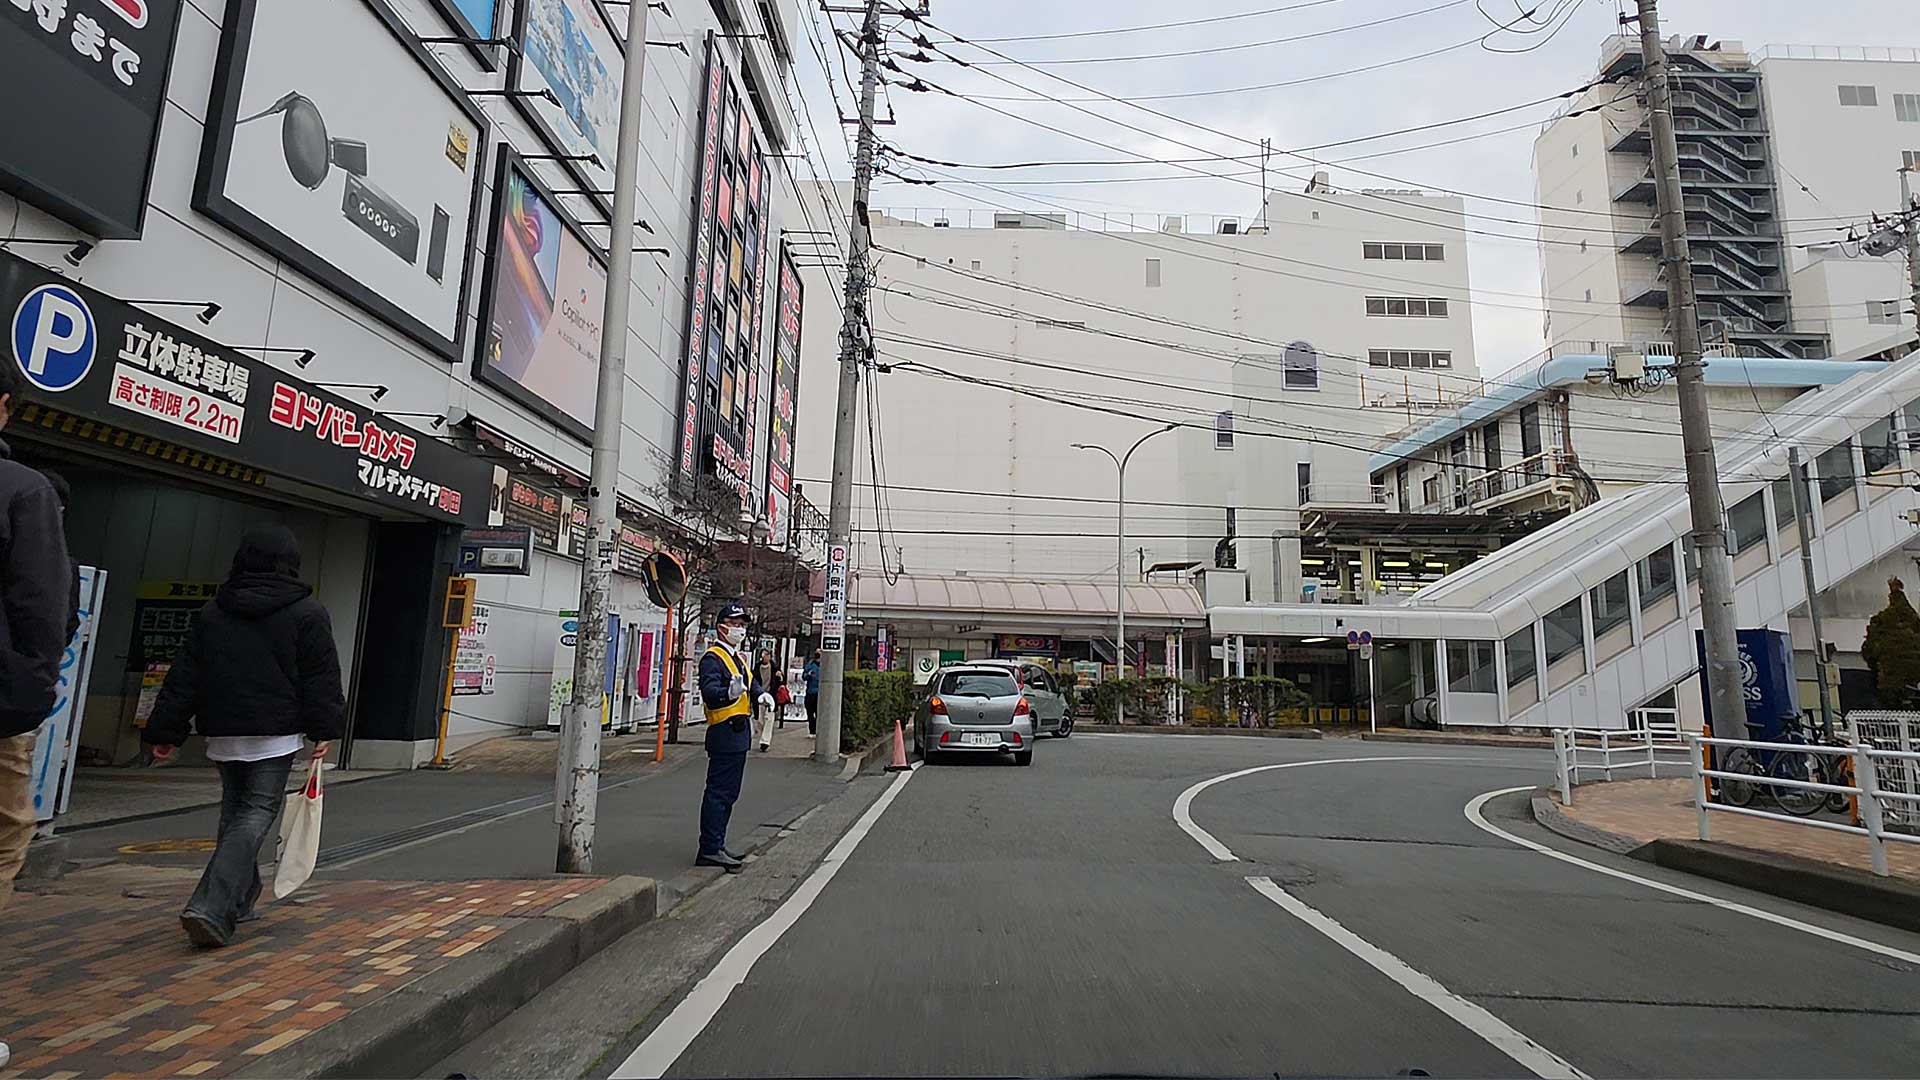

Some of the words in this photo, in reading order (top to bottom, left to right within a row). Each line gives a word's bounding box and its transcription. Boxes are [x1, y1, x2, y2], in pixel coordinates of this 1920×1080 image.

[28, 291, 88, 376] P
[118, 322, 250, 404] 立体駐車場
[115, 375, 183, 418] 高さ制限
[184, 396, 239, 438] 2.2m
[270, 381, 417, 470] ヨドバシカメラ
[491, 483, 506, 515] B1
[463, 551, 475, 564] P
